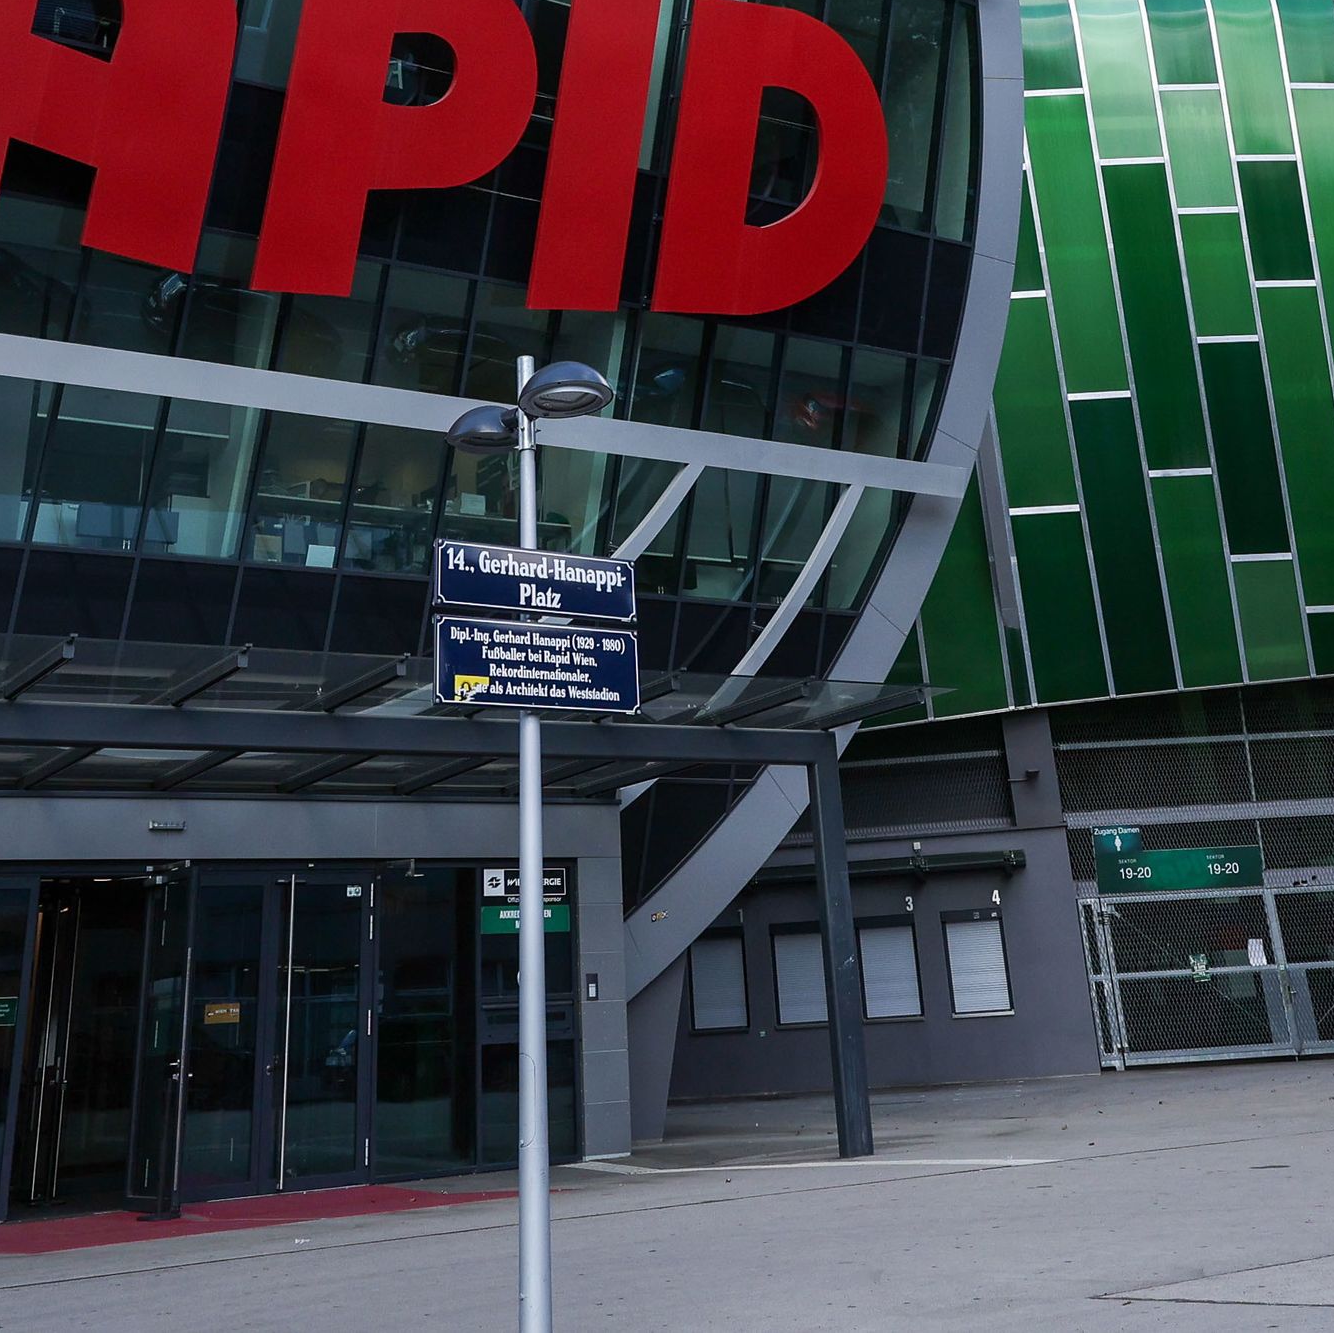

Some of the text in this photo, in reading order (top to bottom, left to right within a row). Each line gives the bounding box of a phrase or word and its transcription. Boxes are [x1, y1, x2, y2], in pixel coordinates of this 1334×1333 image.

[446, 547, 626, 592] 14., Gerhard-Hanappi-
[519, 583, 561, 608] Platz
[450, 626, 492, 645] Dipl.-Ing.
[493, 630, 531, 645] Gerhard
[532, 631, 570, 649] Hanappi
[571, 634, 594, 650] (1929
[602, 637, 625, 654] 1980)
[482, 647, 598, 667] Fußballer bei Rapid Wien,
[489, 664, 592, 684] Rekordinternationaler,
[490, 681, 503, 694] als
[505, 681, 548, 697] Architekt
[550, 684, 566, 698] das
[568, 685, 620, 702] Weststadion
[1094, 826, 1140, 836] Zugang Damen
[1119, 862, 1240, 879] 19-20 19-20
[543, 878, 562, 886] RGIE
[905, 896, 914, 912] 3
[992, 889, 1001, 905] 4
